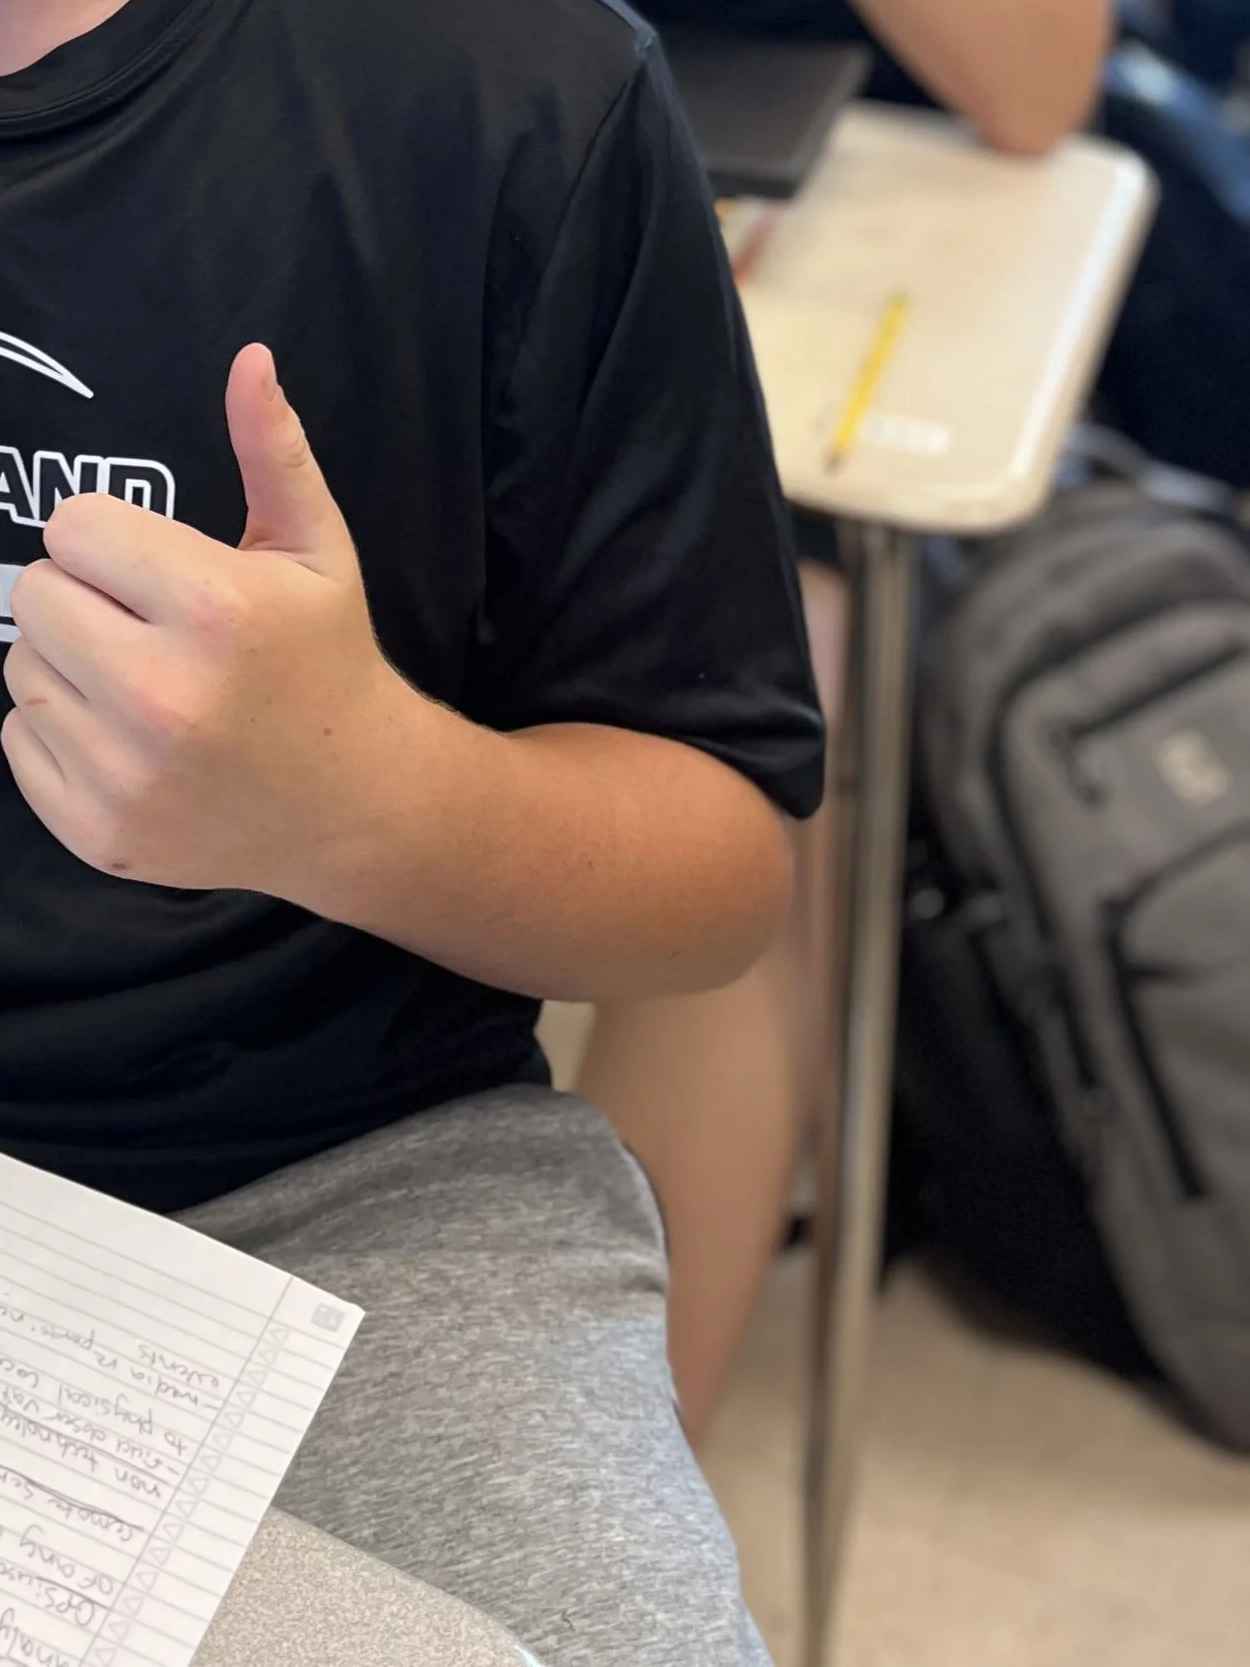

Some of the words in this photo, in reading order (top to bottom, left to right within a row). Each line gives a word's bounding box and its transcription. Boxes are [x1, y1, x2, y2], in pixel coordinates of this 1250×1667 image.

[134, 1343, 221, 1386] events
[56, 1383, 154, 1436] physical
[161, 1432, 186, 1457] to
[112, 1464, 161, 1499] non
[16, 1524, 75, 1578] any
